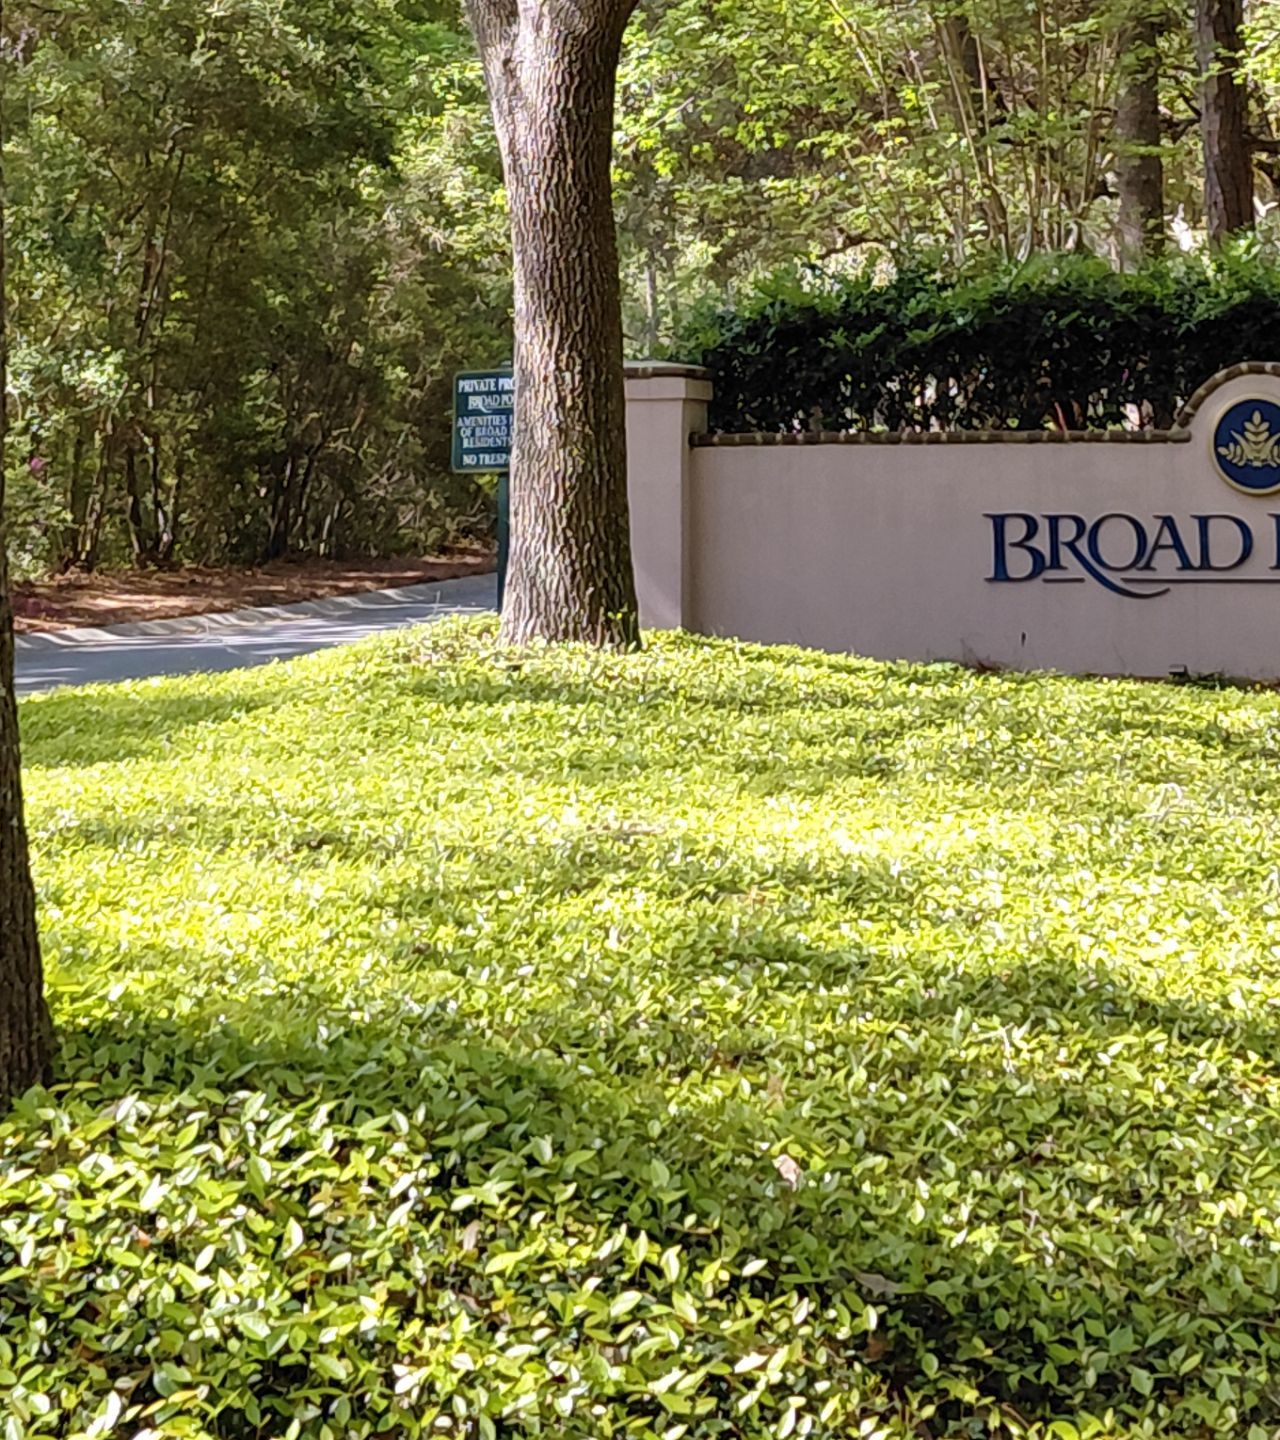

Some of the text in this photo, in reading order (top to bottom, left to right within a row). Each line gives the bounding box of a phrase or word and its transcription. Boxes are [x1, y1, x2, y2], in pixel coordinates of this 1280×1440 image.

[458, 379, 497, 393] PRIVATE
[457, 415, 508, 427] AMENITIES
[460, 427, 473, 438] OF
[462, 454, 477, 466] NO
[982, 512, 1254, 599] BROAD
